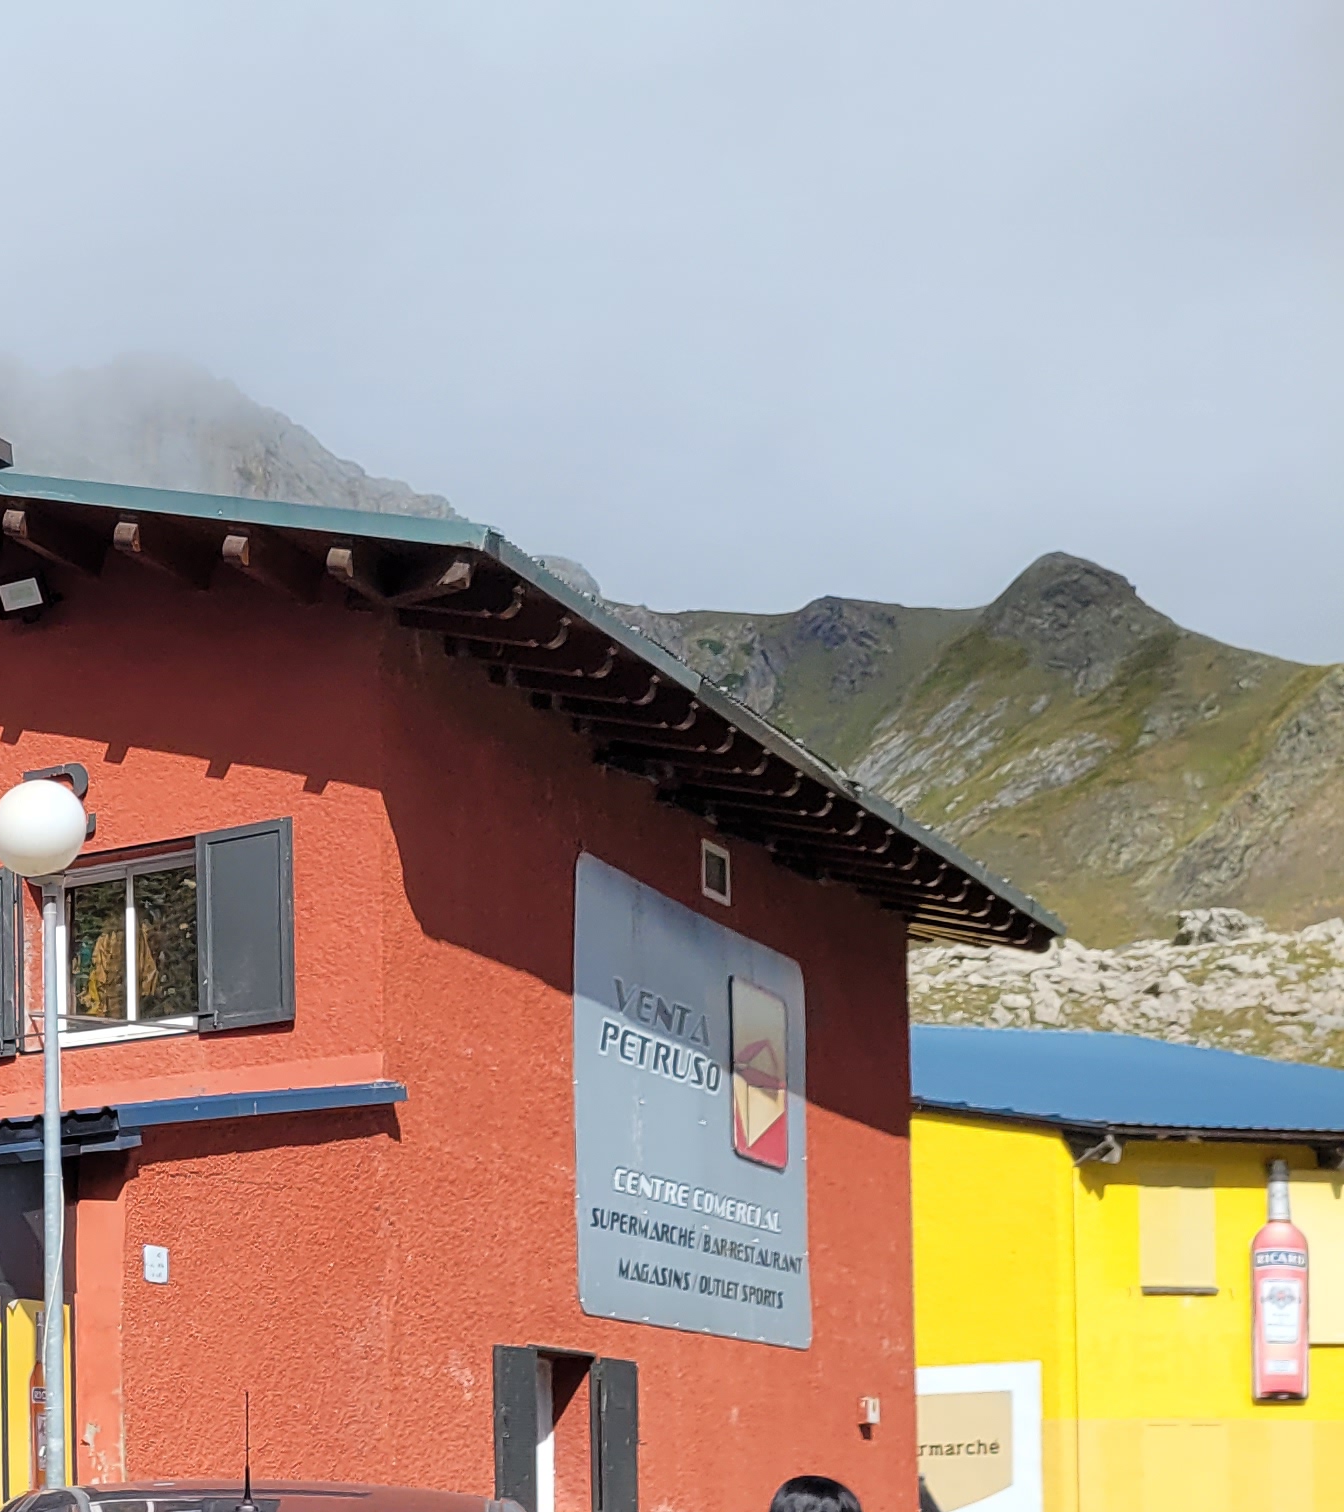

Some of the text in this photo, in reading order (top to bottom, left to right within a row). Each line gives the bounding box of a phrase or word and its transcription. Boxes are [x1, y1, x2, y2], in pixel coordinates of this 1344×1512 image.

[614, 976, 710, 1047] VENTA
[599, 1018, 722, 1094] PETRUSO
[590, 1207, 696, 1249] SUPERMARCHÉ
[614, 1166, 782, 1234] CENTRE COMERCIAL
[618, 1257, 691, 1291] MAGASINS
[699, 1276, 740, 1299] OUTLET
[742, 1284, 784, 1310] SPORTS
